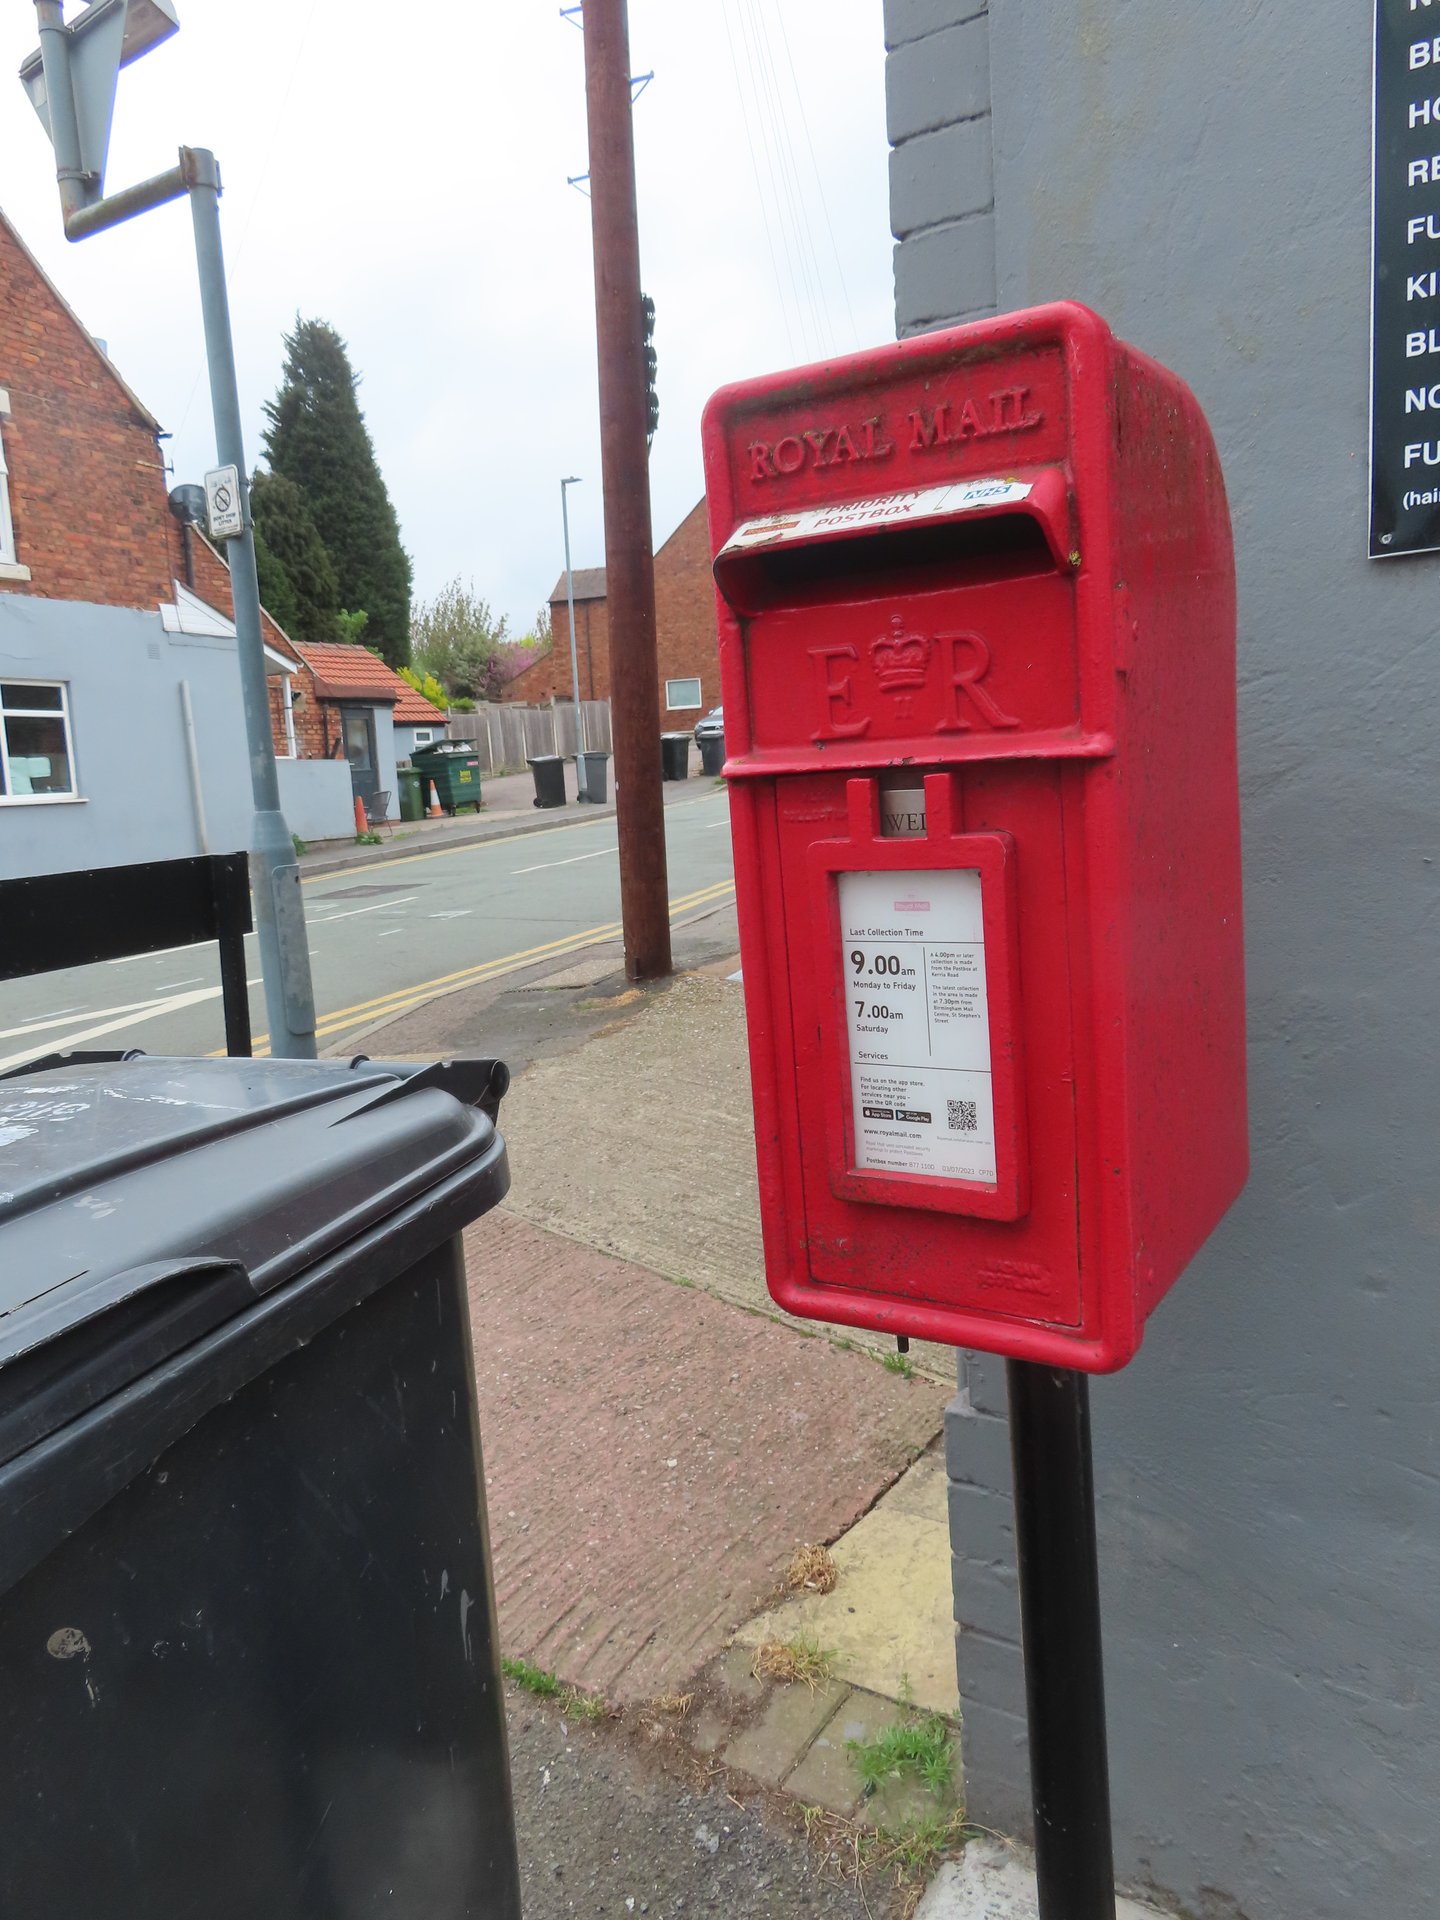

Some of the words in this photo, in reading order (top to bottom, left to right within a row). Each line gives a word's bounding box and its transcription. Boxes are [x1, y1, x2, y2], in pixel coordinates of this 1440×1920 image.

[748, 416, 895, 480] ROYAL
[909, 386, 1043, 449] MAIL
[963, 484, 1012, 500] NHS
[825, 489, 928, 515] PRIORITY
[813, 503, 915, 528] POSTBOX
[807, 643, 871, 741] E
[933, 630, 1022, 734] R
[851, 950, 915, 975] 9.00am
[854, 981, 881, 990] Monday
[893, 982, 916, 991] Friday
[855, 1001, 903, 1019] 7.00am
[857, 1024, 888, 1034] Saturday
[859, 1051, 888, 1060] Services
[864, 1129, 922, 1139] www.royalmail.com
